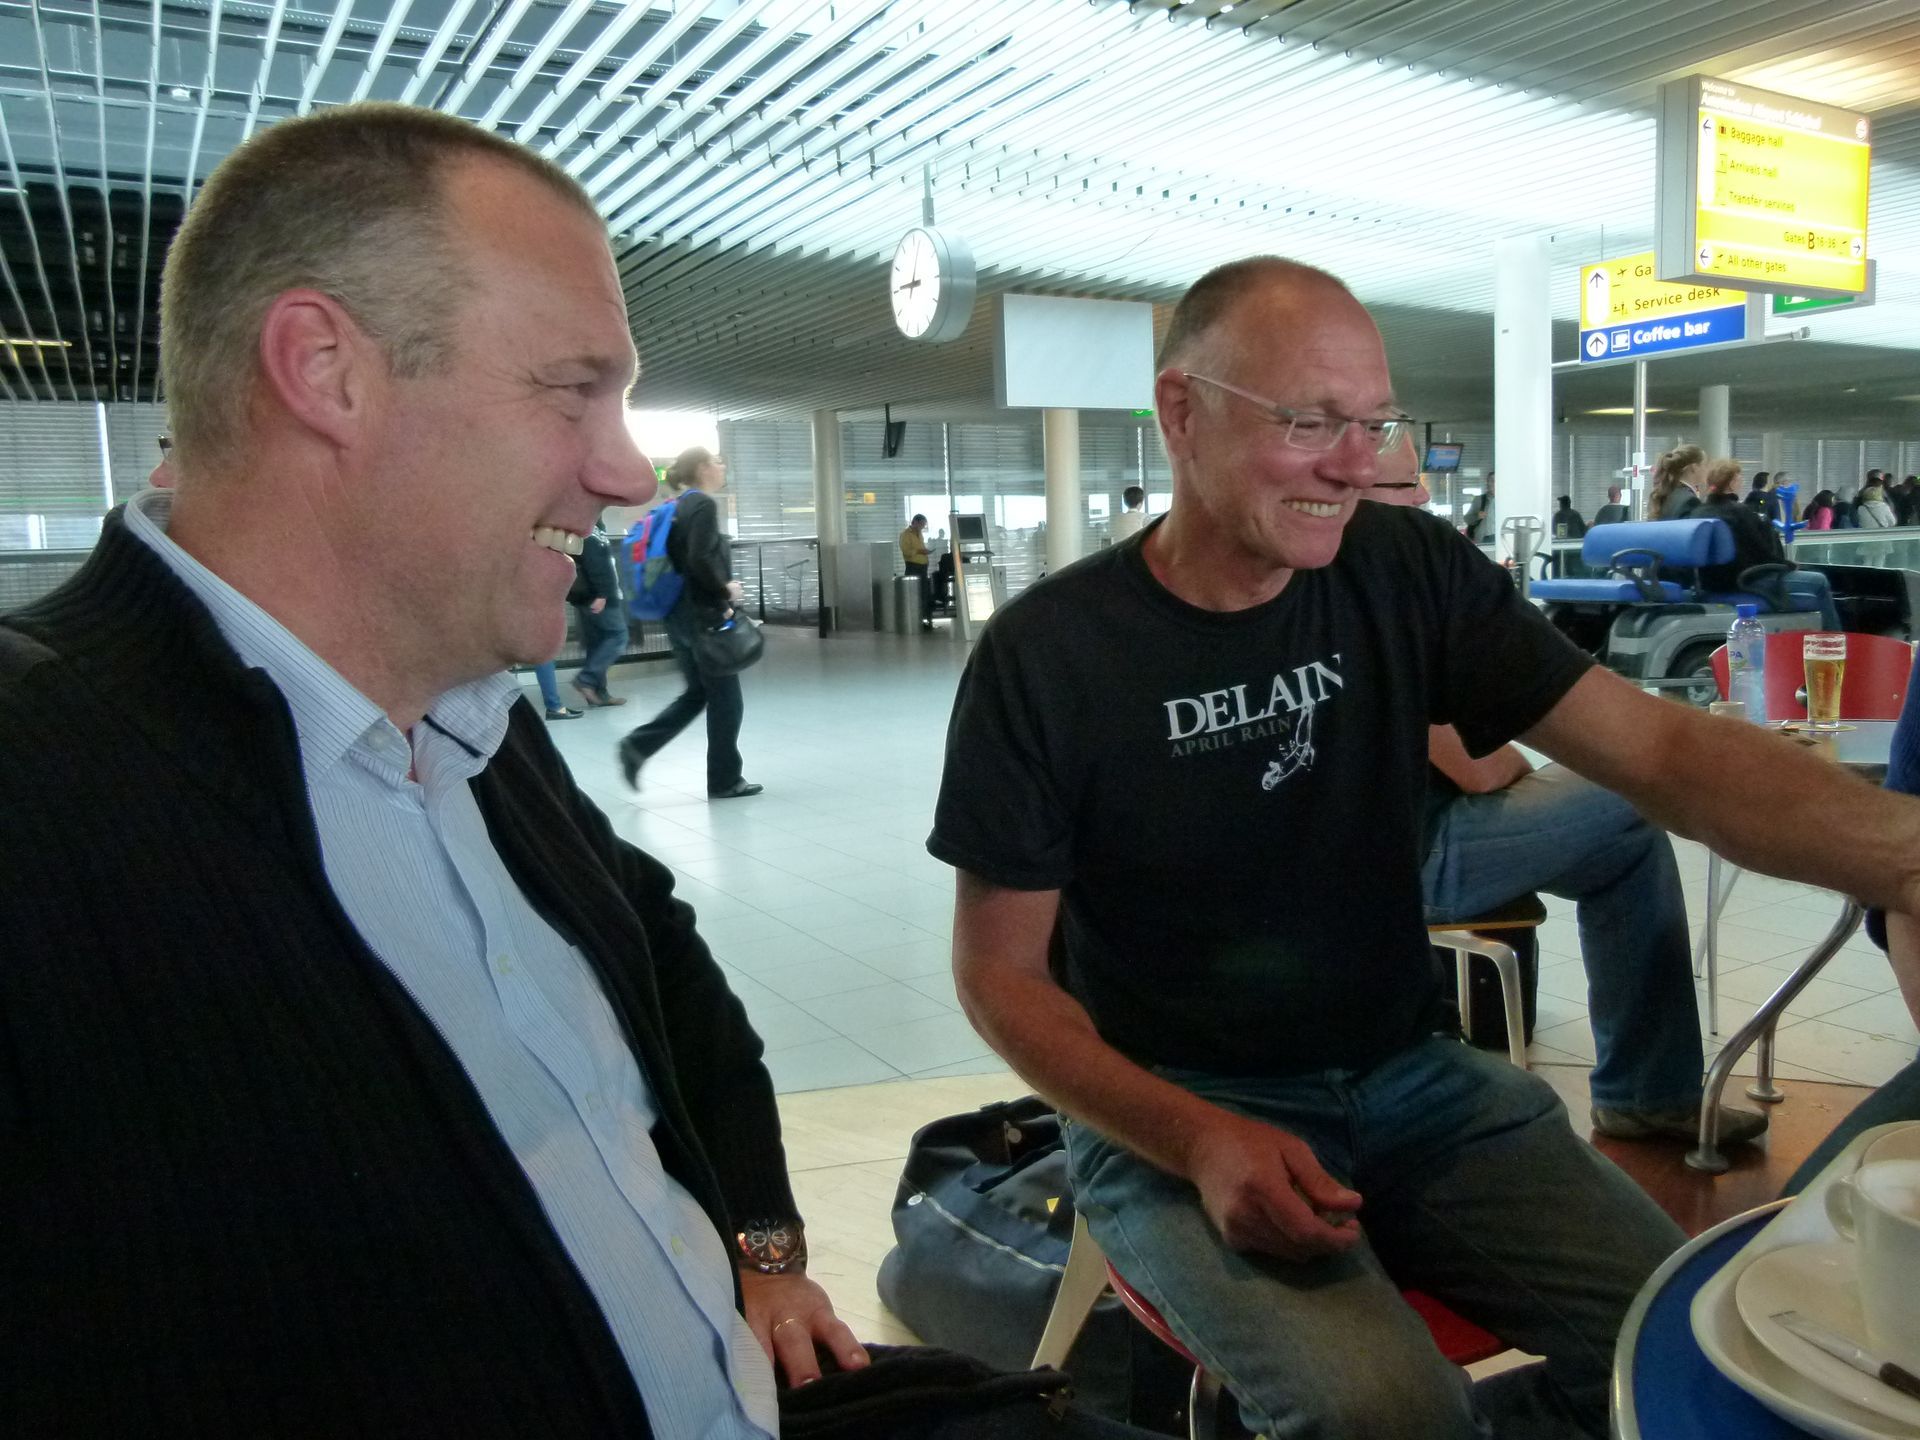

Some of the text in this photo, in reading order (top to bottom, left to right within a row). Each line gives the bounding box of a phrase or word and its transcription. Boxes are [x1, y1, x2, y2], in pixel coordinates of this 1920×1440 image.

[1731, 127, 1766, 146] Baggage
[1808, 232, 1815, 249] B
[1634, 265, 1653, 277] Ga
[1728, 254, 1787, 273] All other gates
[1635, 287, 1720, 310] Service desk
[1633, 321, 1711, 345] Coffee bar
[1163, 653, 1343, 740] DELAIN
[1171, 716, 1292, 758] APRIL RAIN
